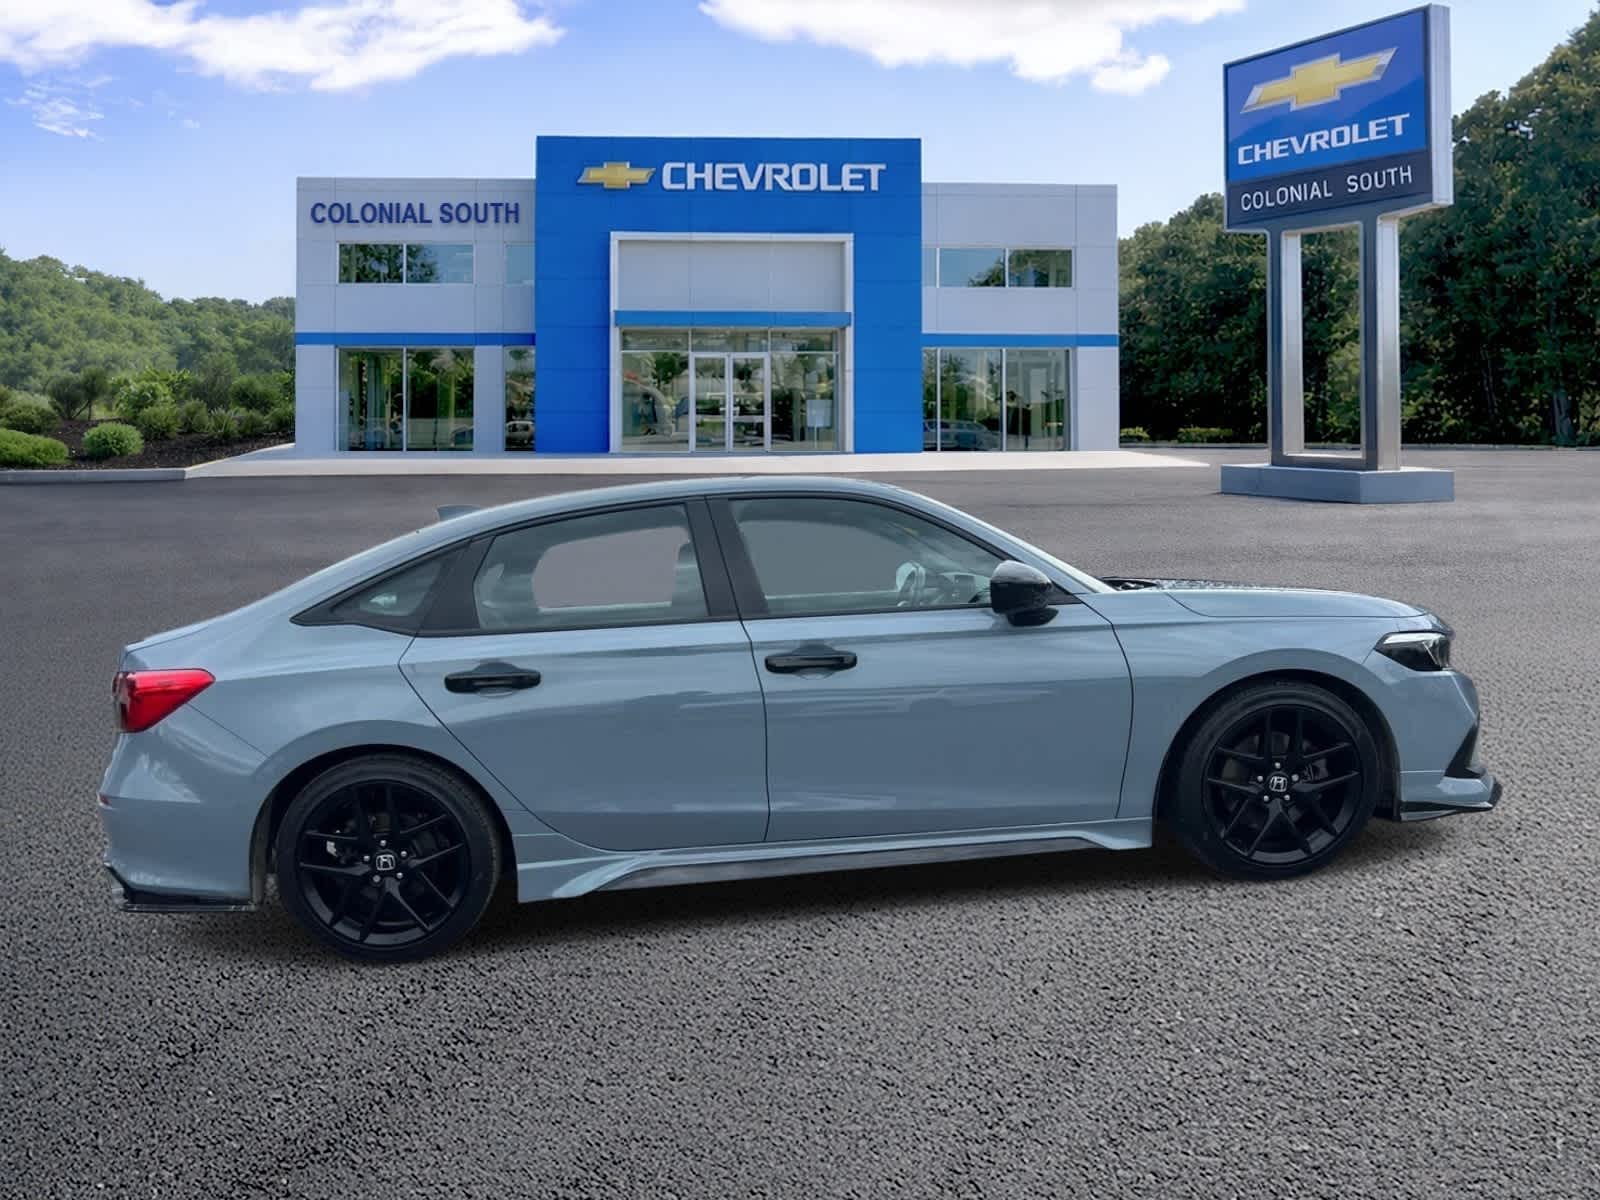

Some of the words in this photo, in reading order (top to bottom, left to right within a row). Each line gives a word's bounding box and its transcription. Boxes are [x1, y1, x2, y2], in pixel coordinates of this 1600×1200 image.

[1237, 113, 1410, 165] CHEVROLET
[661, 161, 887, 193] CHEVROLET
[1240, 180, 1333, 211] COLONIAL
[1346, 165, 1412, 193] SOUTH
[310, 202, 433, 224] COLONIAL
[439, 202, 520, 224] SOUTH
